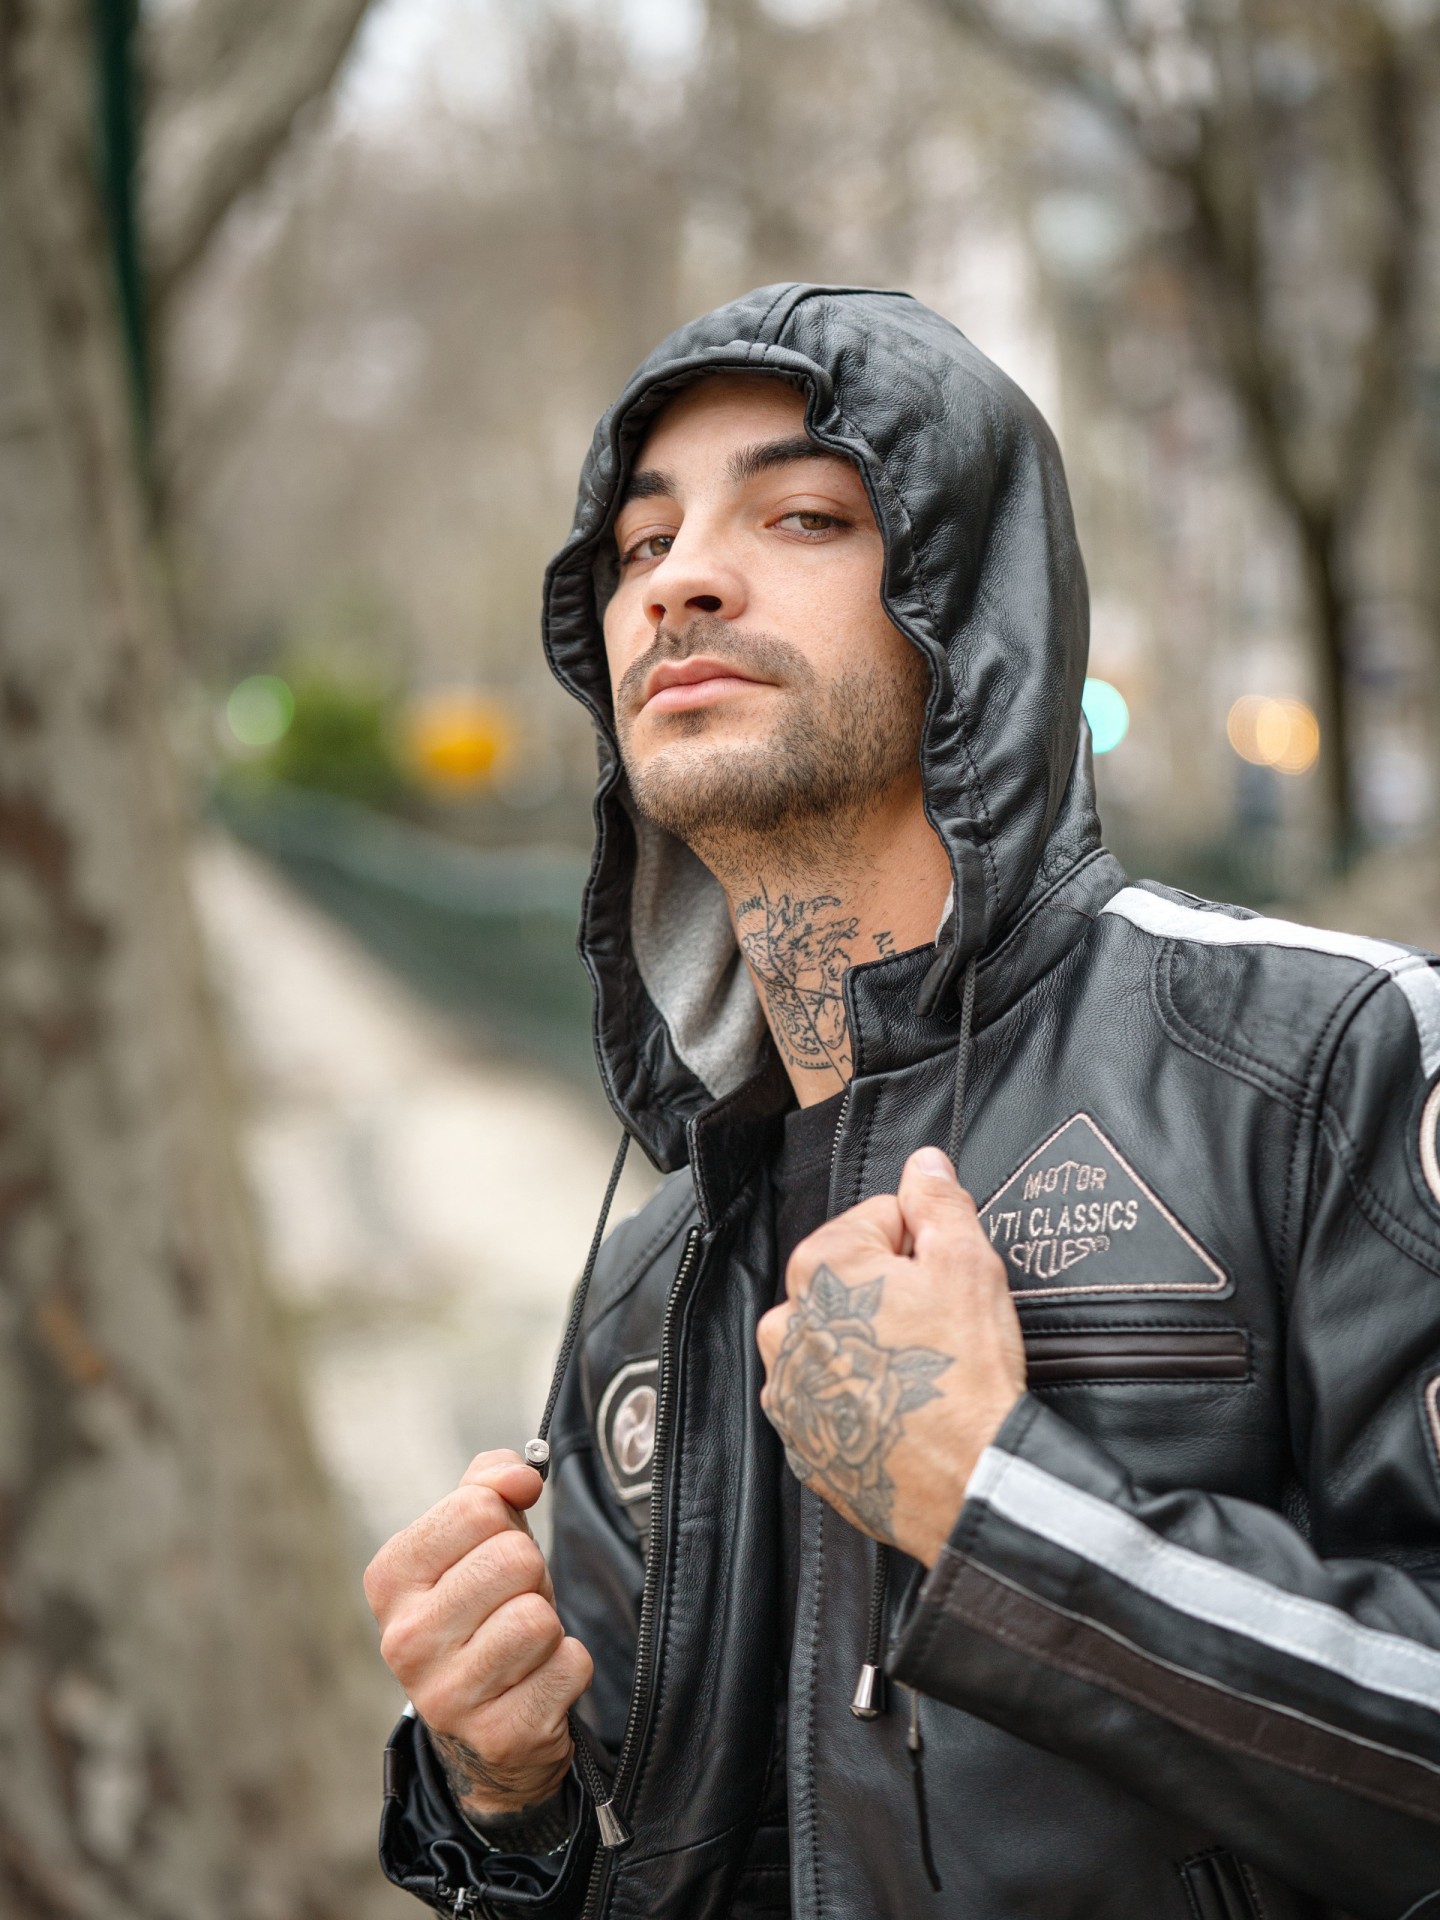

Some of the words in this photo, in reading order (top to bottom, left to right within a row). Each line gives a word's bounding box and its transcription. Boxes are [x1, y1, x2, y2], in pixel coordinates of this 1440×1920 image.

[1023, 1160, 1107, 1200] MOTOR
[989, 1210, 1022, 1243] VTI
[1028, 1200, 1138, 1237] CLASSICS
